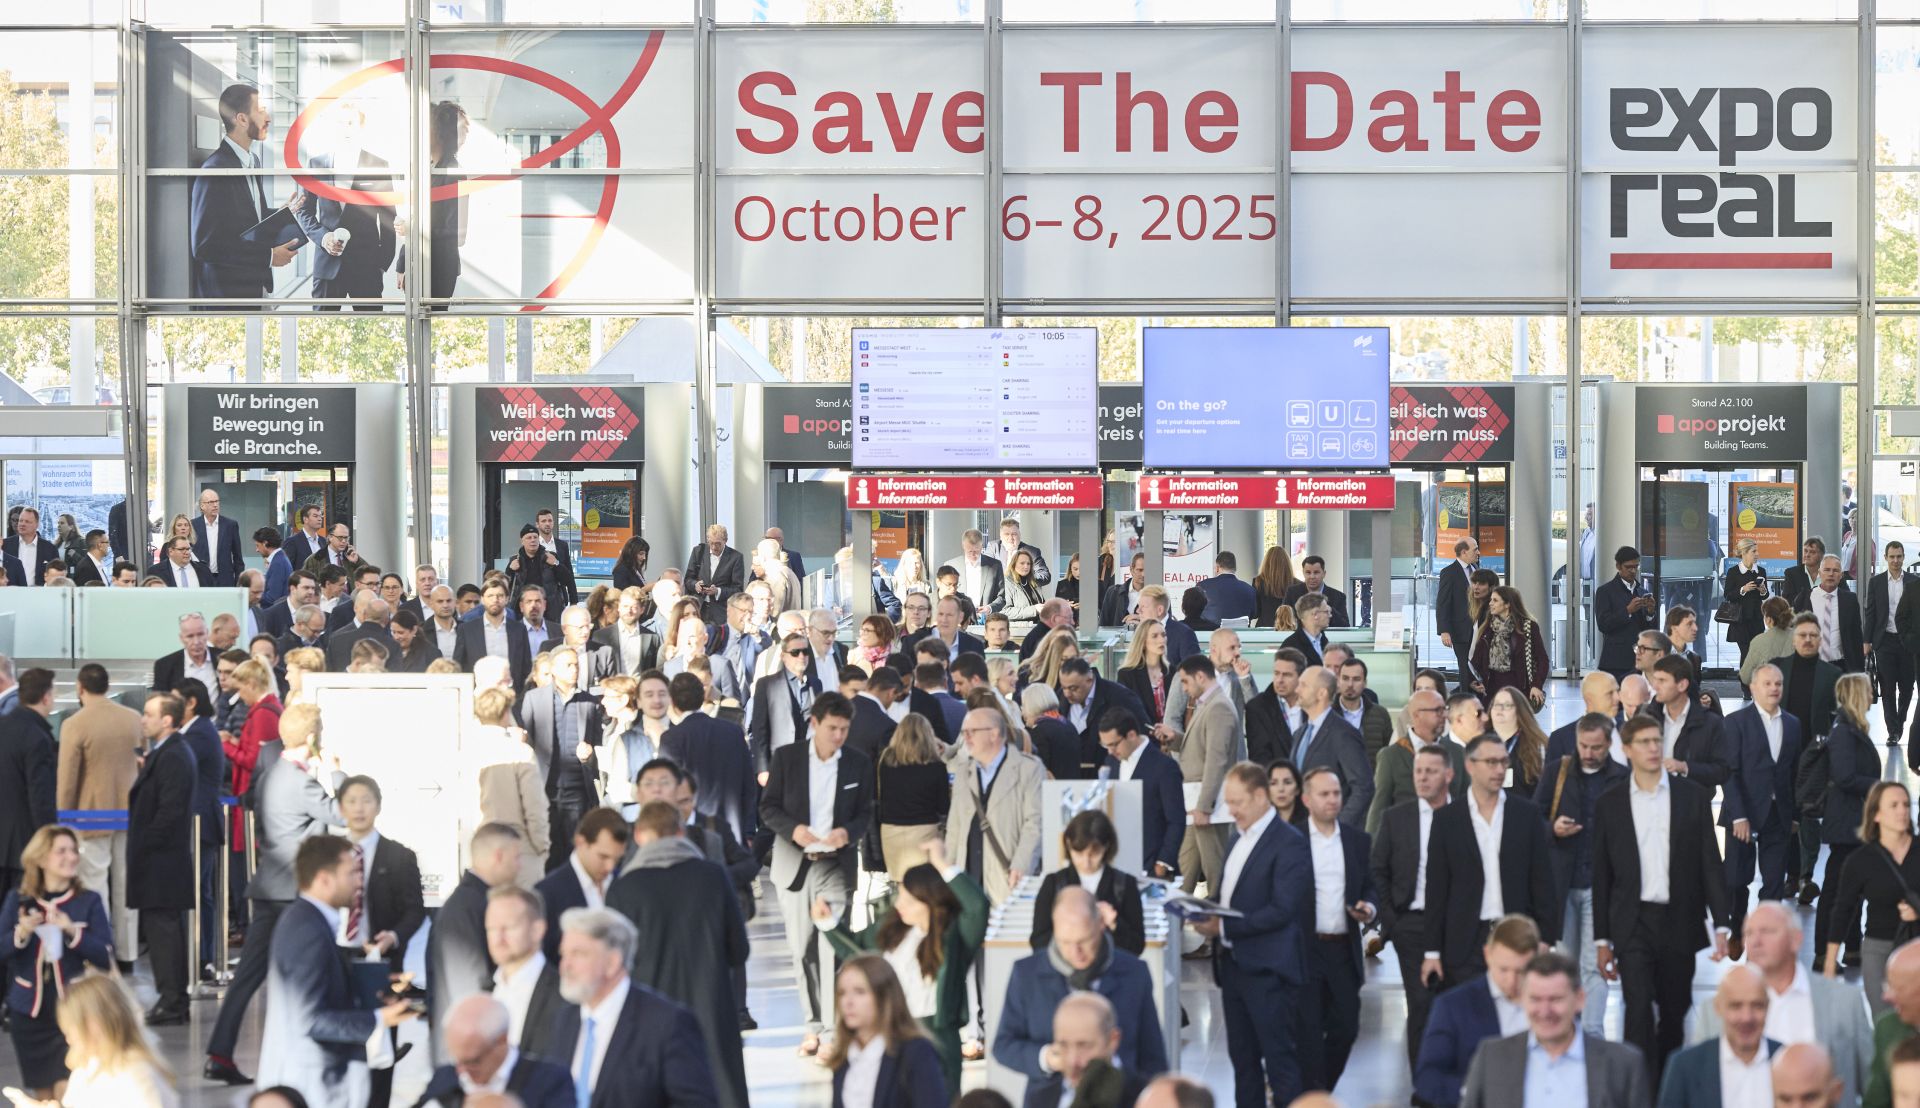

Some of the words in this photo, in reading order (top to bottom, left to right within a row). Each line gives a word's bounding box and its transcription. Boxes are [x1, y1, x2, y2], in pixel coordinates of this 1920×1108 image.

[736, 71, 984, 155] Save
[1040, 72, 1239, 153] The
[1292, 71, 1541, 153] Date
[1610, 88, 1832, 165] expo
[735, 194, 966, 242] October
[1142, 193, 1276, 242] 2025
[1042, 332, 1065, 341] 10:05
[217, 393, 247, 409] Wir
[250, 393, 319, 413] bringen
[815, 398, 840, 408] Stand
[1156, 400, 1175, 411] On
[1178, 400, 1200, 411] the
[1204, 400, 1228, 413] go?
[1691, 397, 1717, 408] Stand
[1719, 397, 1753, 408] A2.100
[501, 403, 537, 419] Weil
[541, 403, 576, 419] sich
[580, 406, 616, 419] was
[1113, 402, 1144, 422] geh
[1390, 402, 1408, 418] eil
[1412, 402, 1448, 418] sich
[1453, 406, 1487, 418] was
[213, 416, 304, 436] Bewegung
[308, 416, 324, 432] in
[802, 419, 852, 437] apop
[1679, 414, 1786, 437] apoprojekt
[490, 425, 576, 443] verändern
[580, 429, 628, 443] muss.
[1291, 434, 1309, 442] TAXI
[1452, 429, 1499, 442] muss.
[214, 439, 241, 455] die
[244, 439, 322, 455] Branche.
[827, 440, 852, 450] Buildi
[1703, 440, 1738, 452] Building
[1739, 440, 1769, 450] Teams.
[878, 479, 947, 491] Information
[1005, 479, 1074, 491] Information
[1169, 479, 1239, 491] Information
[1296, 479, 1366, 491] Information
[878, 492, 948, 505] Information
[1005, 492, 1075, 505] Information
[1169, 492, 1239, 505] Information
[1297, 492, 1367, 505] Information
[1164, 573, 1185, 583] EAL
